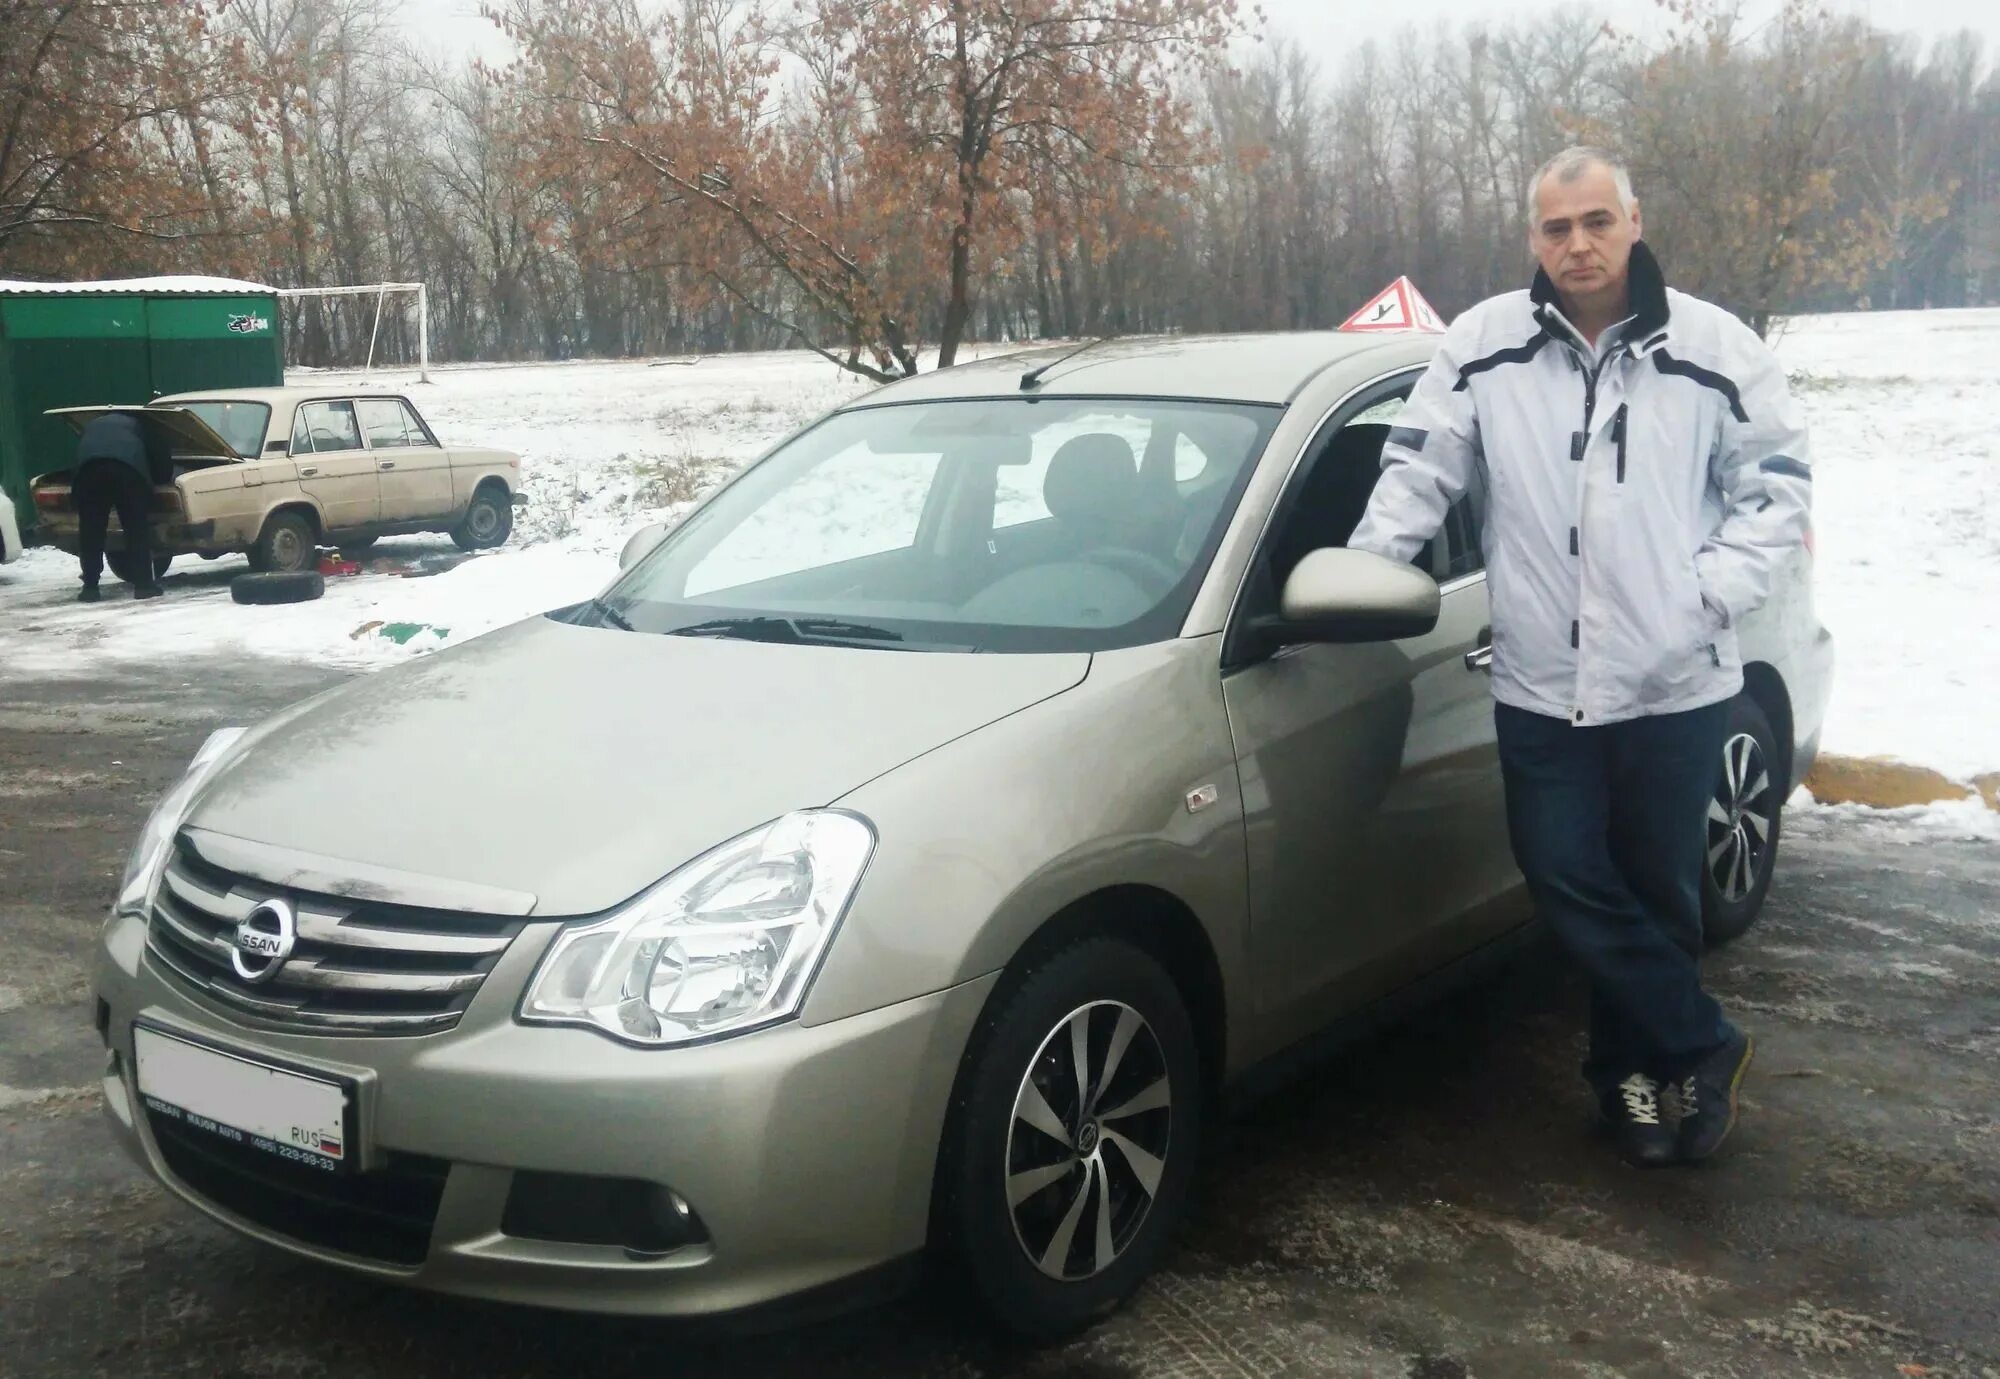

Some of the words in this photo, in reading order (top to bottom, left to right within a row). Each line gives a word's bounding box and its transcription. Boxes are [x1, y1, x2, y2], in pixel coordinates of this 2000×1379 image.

[241, 934, 281, 953] SSAN
[218, 1124, 243, 1142] AUTO
[291, 1126, 320, 1148] RUS
